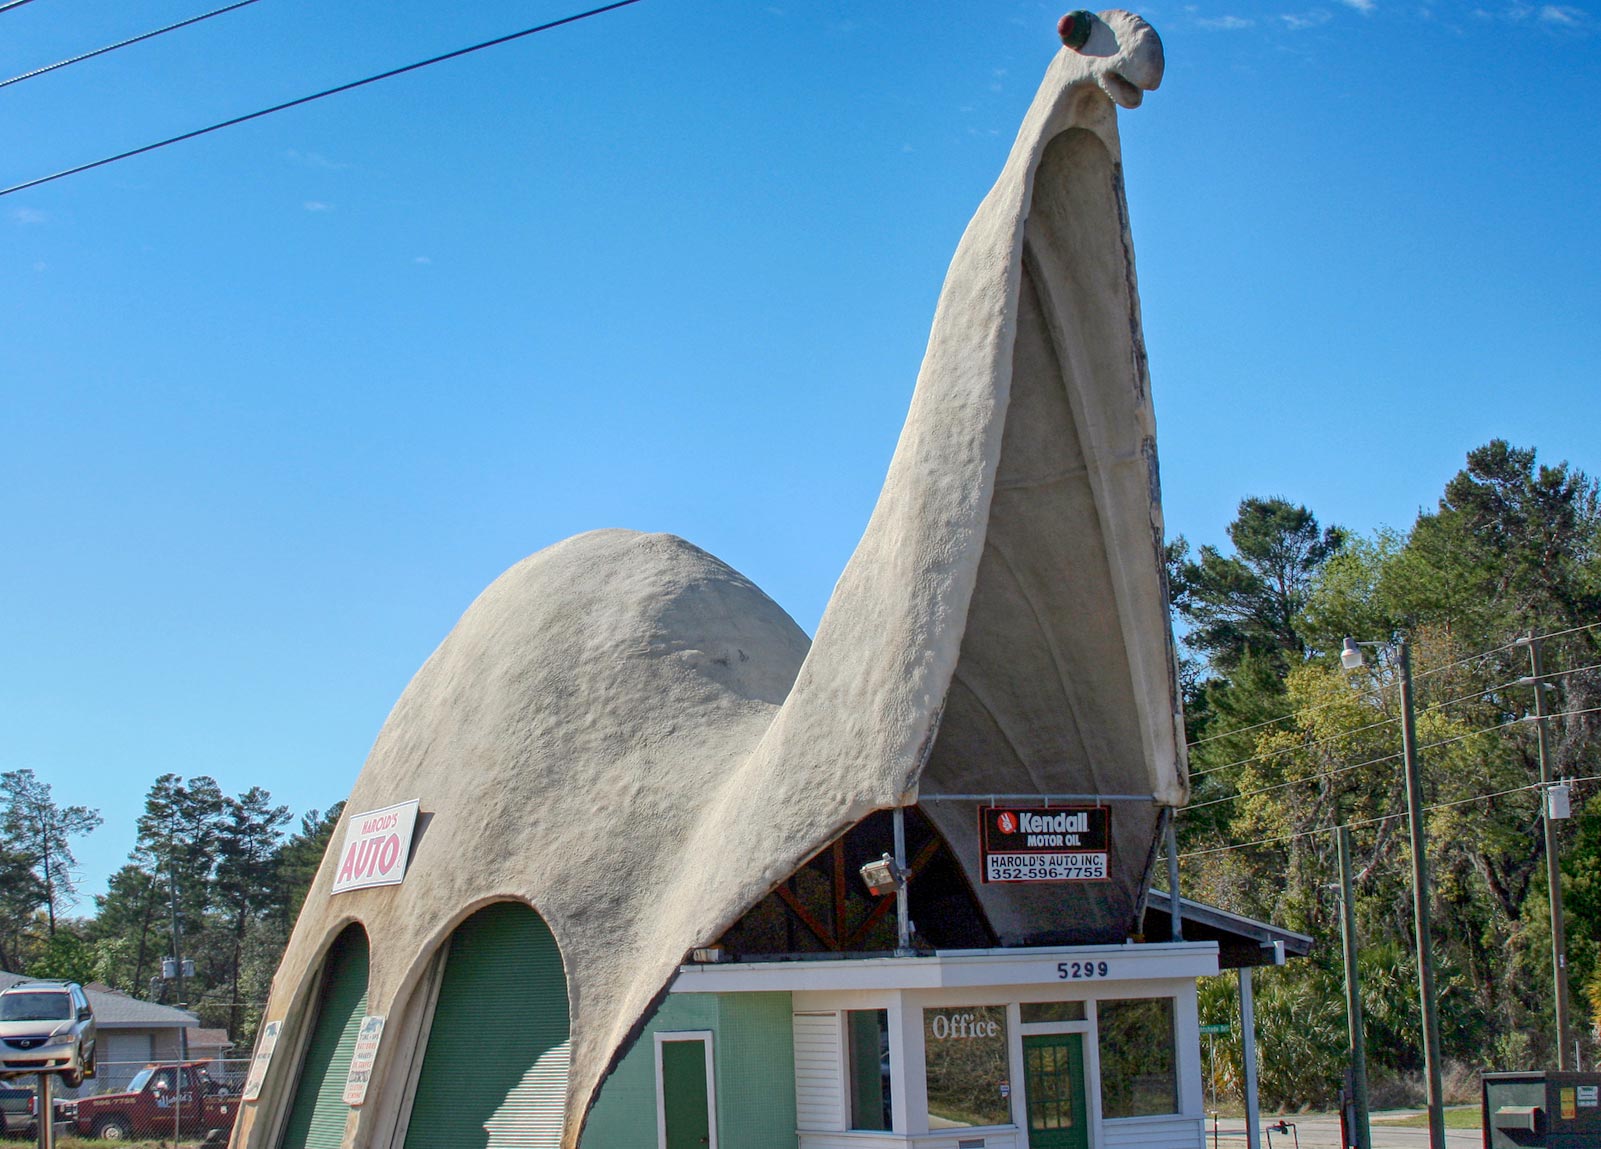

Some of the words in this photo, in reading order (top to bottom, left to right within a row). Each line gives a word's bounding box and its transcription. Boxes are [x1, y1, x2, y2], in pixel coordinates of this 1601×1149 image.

[361, 812, 398, 835] HAROLD'S
[1020, 812, 1088, 833] Kendall
[1027, 834, 1063, 847] MOTOR
[1065, 834, 1081, 846] OIL
[337, 832, 400, 884] AUTO
[991, 856, 1045, 868] HAROLD'S
[1049, 855, 1079, 866] AUTO
[1081, 855, 1103, 866] INC.
[992, 867, 1103, 880] 352-596-7755
[1057, 961, 1108, 979] 5299
[932, 1013, 998, 1039] Office
